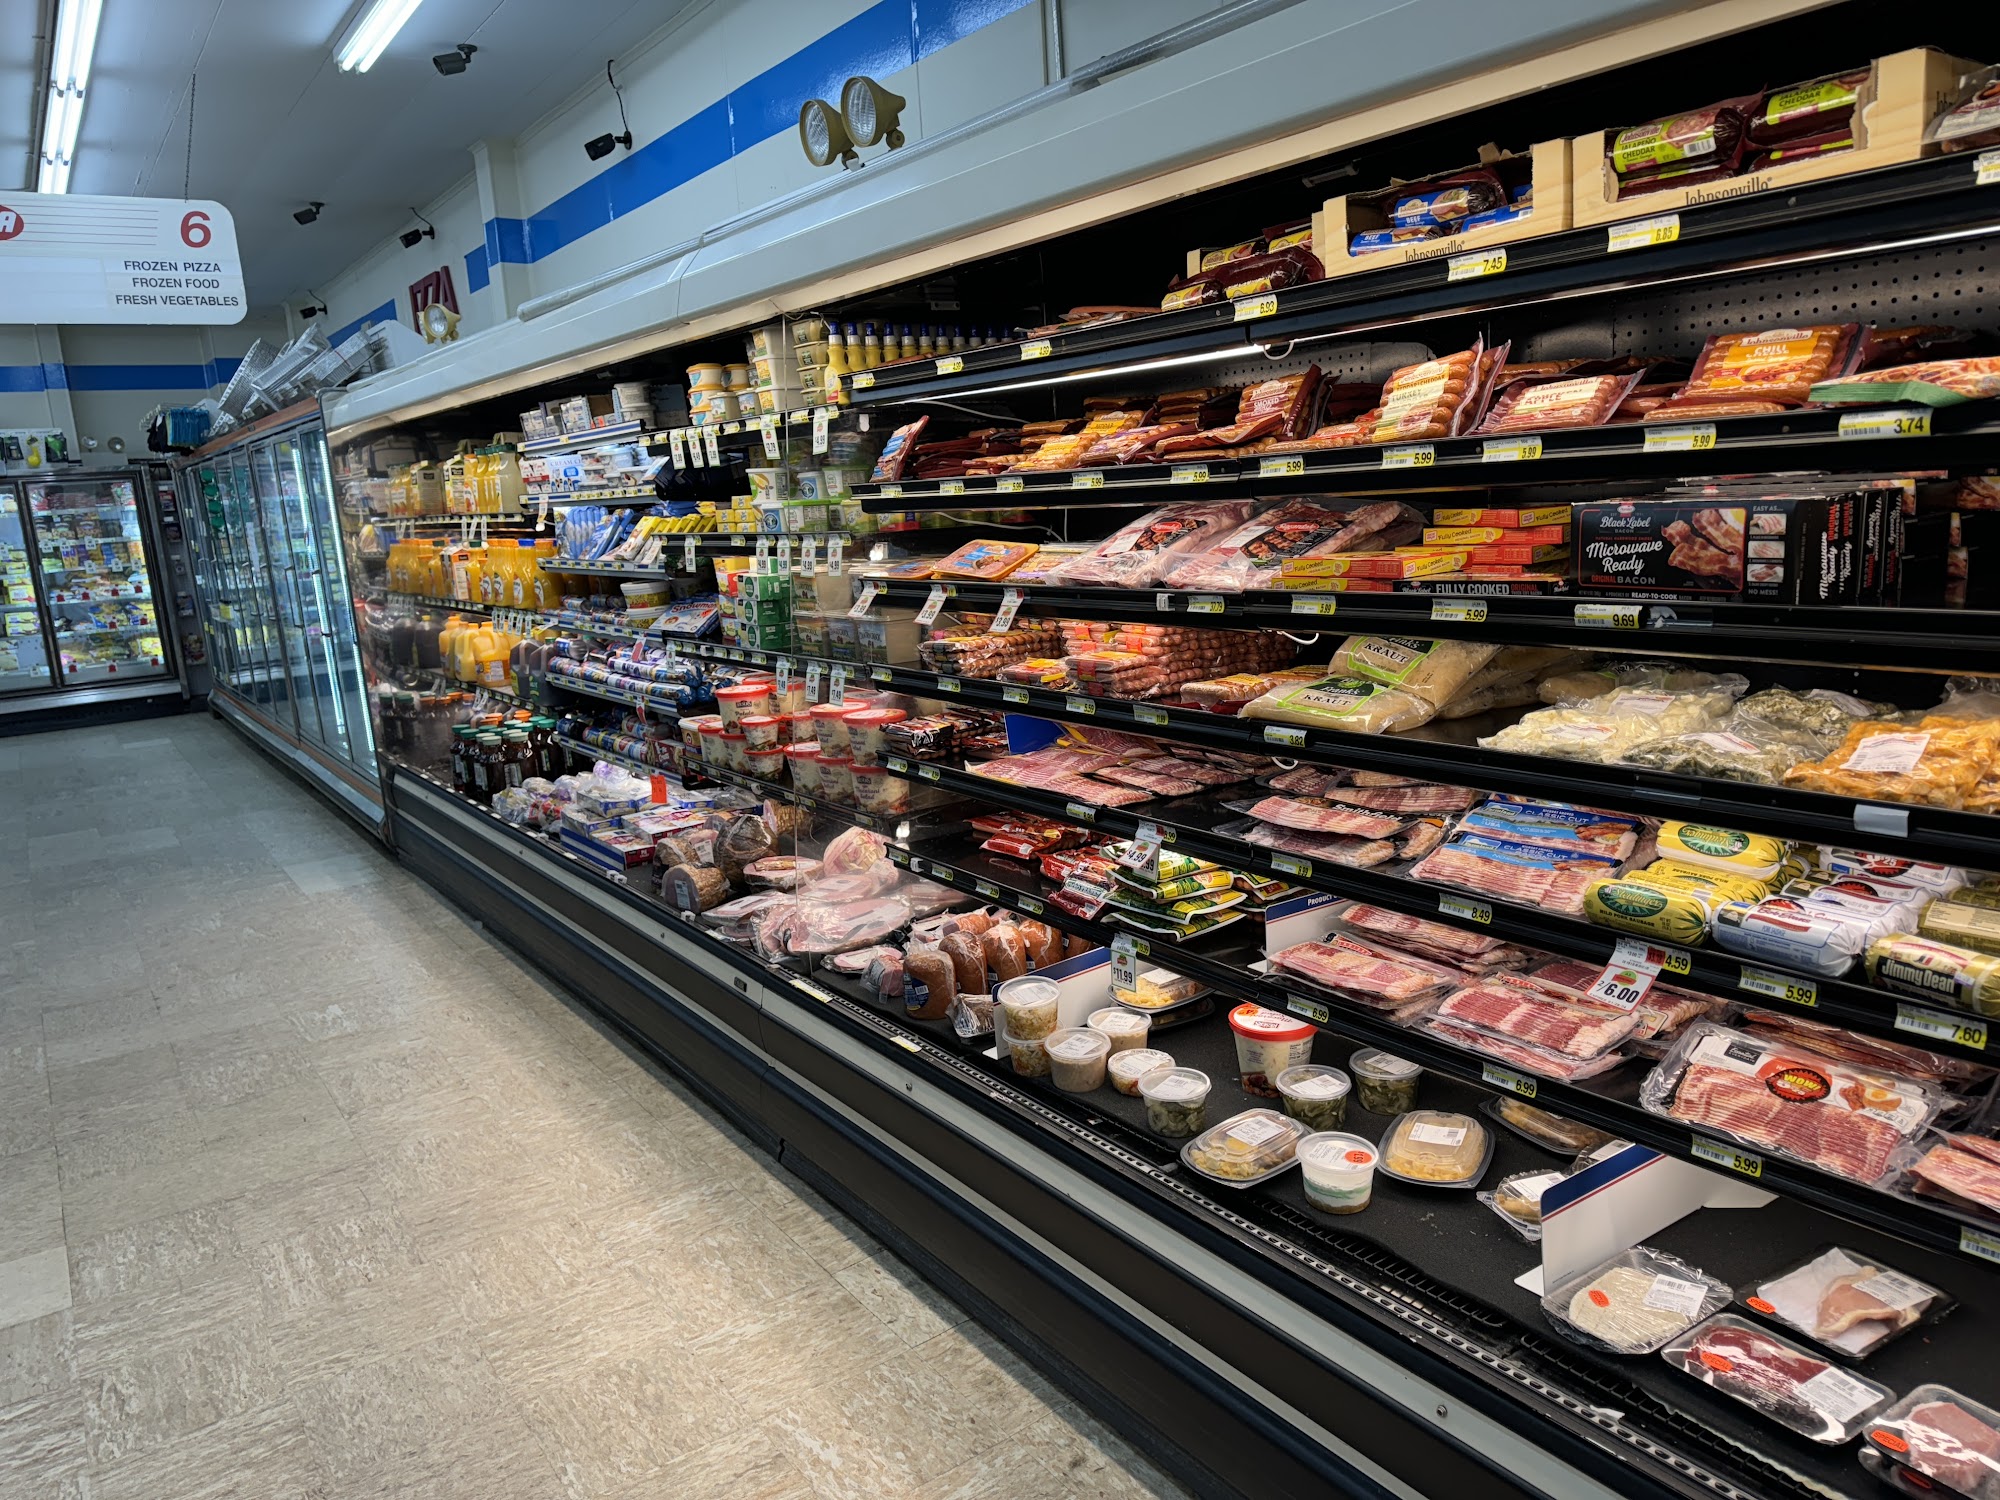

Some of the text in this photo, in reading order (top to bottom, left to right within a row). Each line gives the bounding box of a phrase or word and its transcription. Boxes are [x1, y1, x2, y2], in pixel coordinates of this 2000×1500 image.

[1779, 90, 1821, 107] CHEDDAR
[1622, 146, 1655, 160] CHEDDAR
[1406, 216, 1421, 224] BEEF
[180, 211, 212, 248] 6
[1656, 226, 1672, 242] 6.85
[124, 260, 222, 273] FROZEN PIZZA
[1483, 256, 1503, 272] 7.45
[132, 278, 220, 289] FROZEN FOOD
[116, 294, 239, 306] FRESH VEGETABLES
[1260, 300, 1274, 314] 6.93
[1894, 416, 1924, 434] 3.74
[1692, 435, 1710, 448] 5.99
[1414, 452, 1432, 465] 5.99
[1522, 446, 1536, 458] 5.99
[1286, 460, 1302, 473] 5.99
[1090, 477, 1102, 487] 5.99
[1193, 472, 1206, 482] 5.99
[1600, 516, 1652, 529] Black Label
[1828, 503, 1836, 542] ORIGINAL
[1438, 532, 1451, 540] Fully
[1452, 528, 1472, 536] Cooked
[1866, 512, 1876, 548] Ready
[1586, 540, 1664, 558] Microwave
[1294, 560, 1324, 572] Fully Cooked
[1428, 558, 1444, 567] Cooked
[1602, 554, 1645, 576] Ready
[1819, 531, 1828, 600] Microwave
[1828, 546, 1838, 584] Ready
[1844, 541, 1852, 578] Ready
[1299, 579, 1318, 588] Cooked
[1591, 575, 1656, 584] ORIGINAL BACON
[1436, 584, 1466, 594] FULLY
[1468, 584, 1510, 594] COOKED
[1632, 592, 1678, 600] READY-TO-COOK
[1320, 603, 1332, 612] 5.99
[1464, 610, 1485, 620] 5.99
[1612, 614, 1635, 626] 9.69
[1364, 643, 1408, 664] KRAUT
[1320, 686, 1362, 696] Frank's
[1304, 694, 1352, 706] KRAUT
[1289, 735, 1304, 746] 3.82
[1333, 803, 1402, 820] Smithfield
[1525, 810, 1590, 824] CLASSIC CUT
[1126, 850, 1147, 862] $4.99
[1504, 844, 1568, 860] CLASSIC CUT
[1308, 894, 1332, 906] PRODUCT
[1471, 907, 1490, 922] 8.49
[1600, 908, 1655, 928] MILD PORK SAUSAGE
[1762, 925, 1771, 933] PORK
[1665, 954, 1688, 970] 4.59
[1114, 966, 1133, 984] $11.99
[1882, 958, 1955, 994] Jimmy Dean
[1786, 985, 1813, 1002] 5.99
[1312, 1007, 1328, 1020] 6.99
[1952, 1024, 1982, 1044] 7.60
[1515, 1082, 1534, 1096] 6.99
[1784, 1074, 1822, 1091] WOW!
[1734, 1155, 1758, 1174] 5.99
[1750, 1298, 1774, 1312] SPECIAL
[1704, 1354, 1730, 1370] SPECIAL
[1874, 1432, 1905, 1450] SPECIAL
